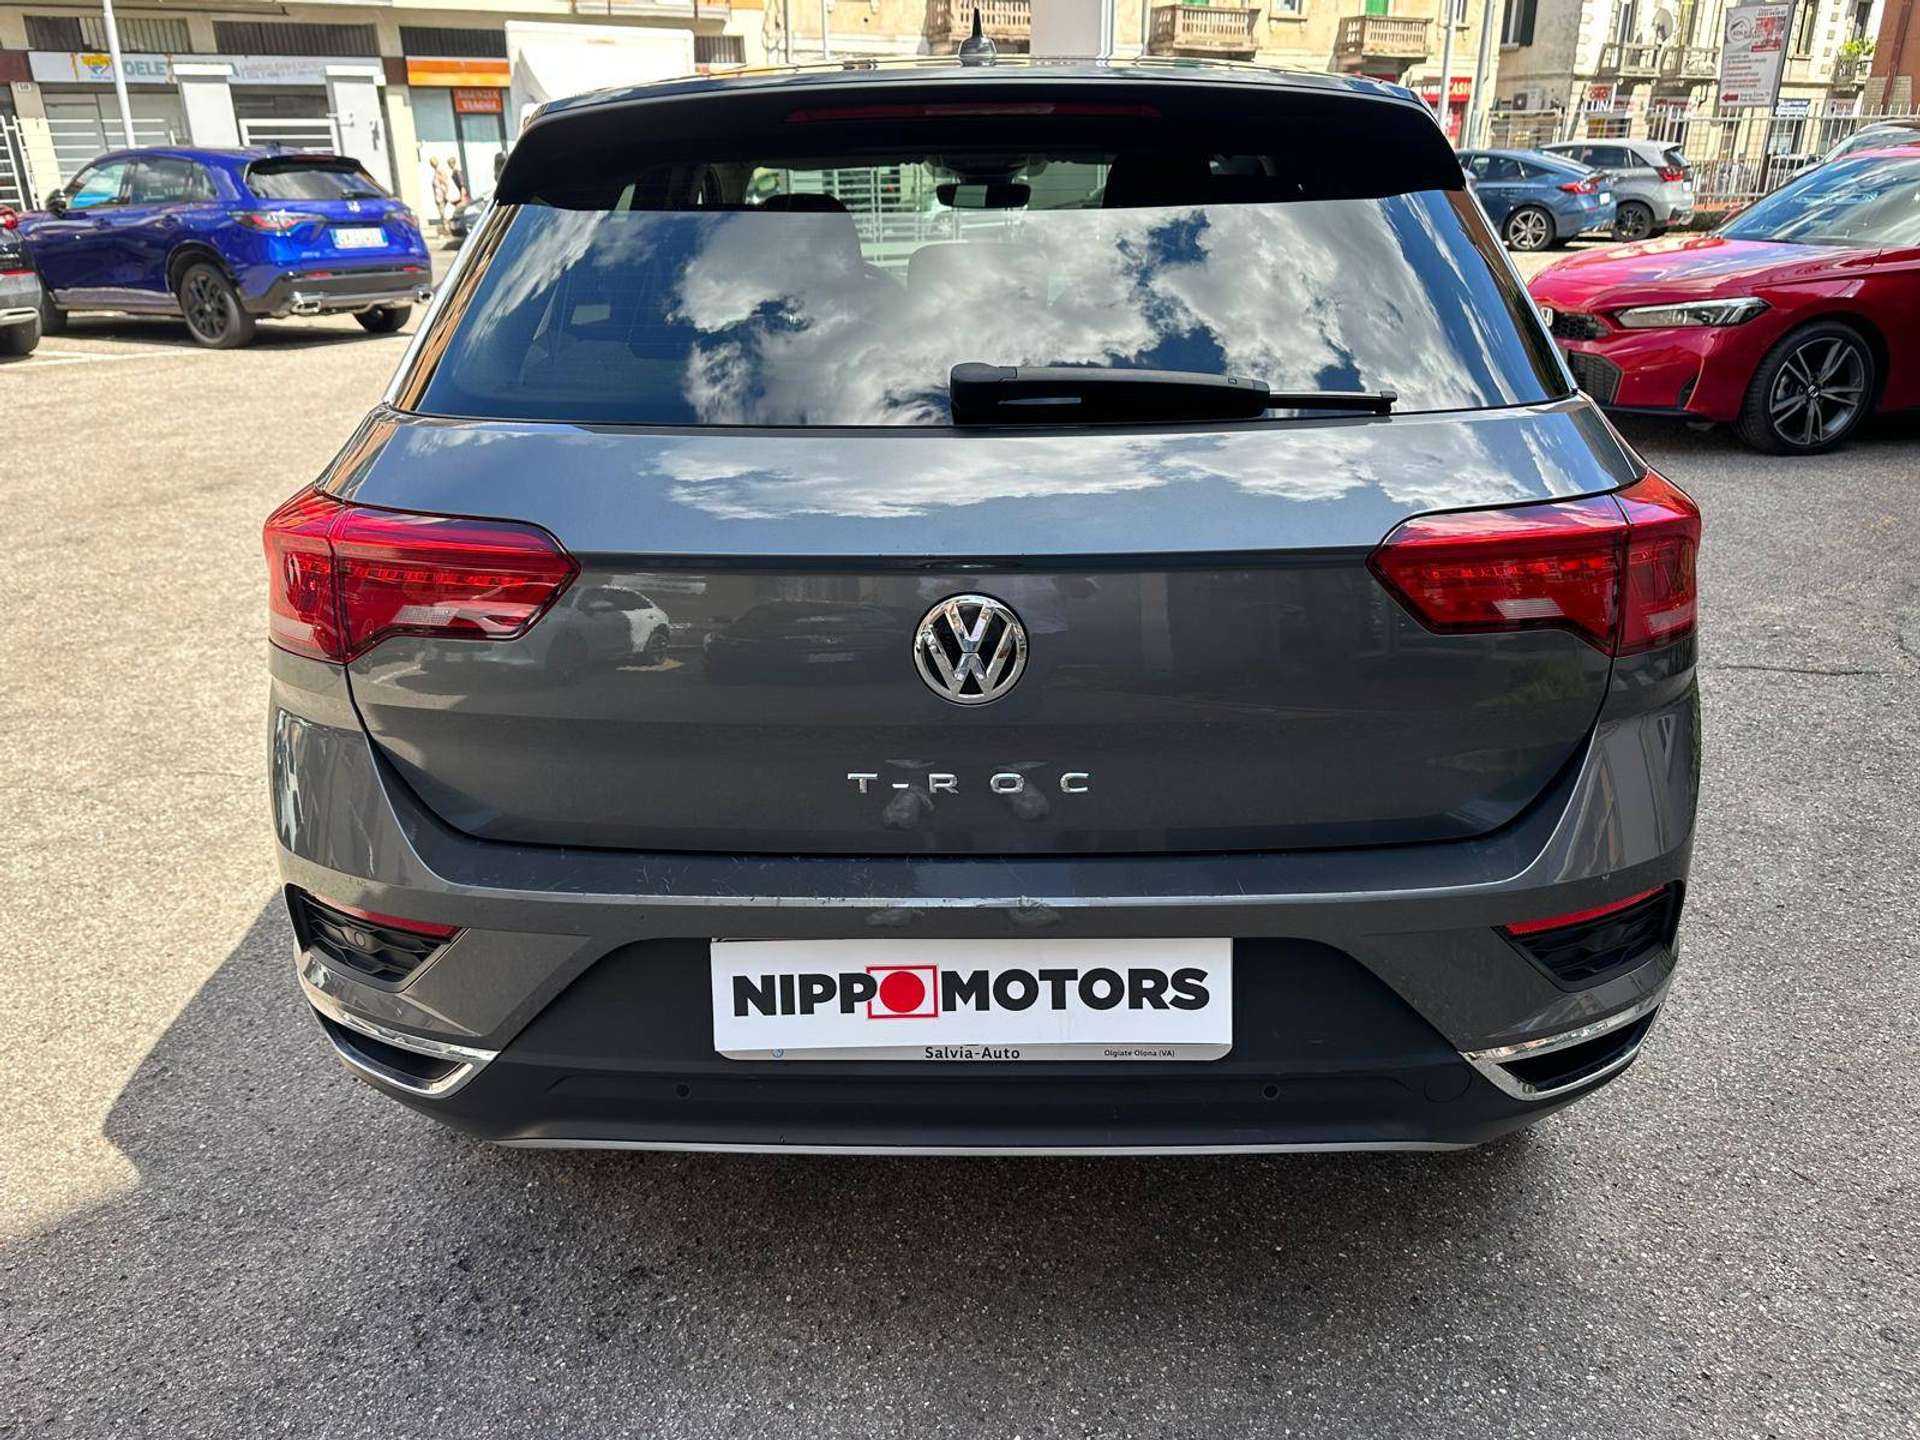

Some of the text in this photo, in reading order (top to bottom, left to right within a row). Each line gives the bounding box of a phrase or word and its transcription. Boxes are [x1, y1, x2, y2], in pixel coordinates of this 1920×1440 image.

[847, 772, 1089, 794] T-ROC
[925, 1046, 1020, 1059] Salvia-Auto
[1104, 1050, 1132, 1058] Olgiate
